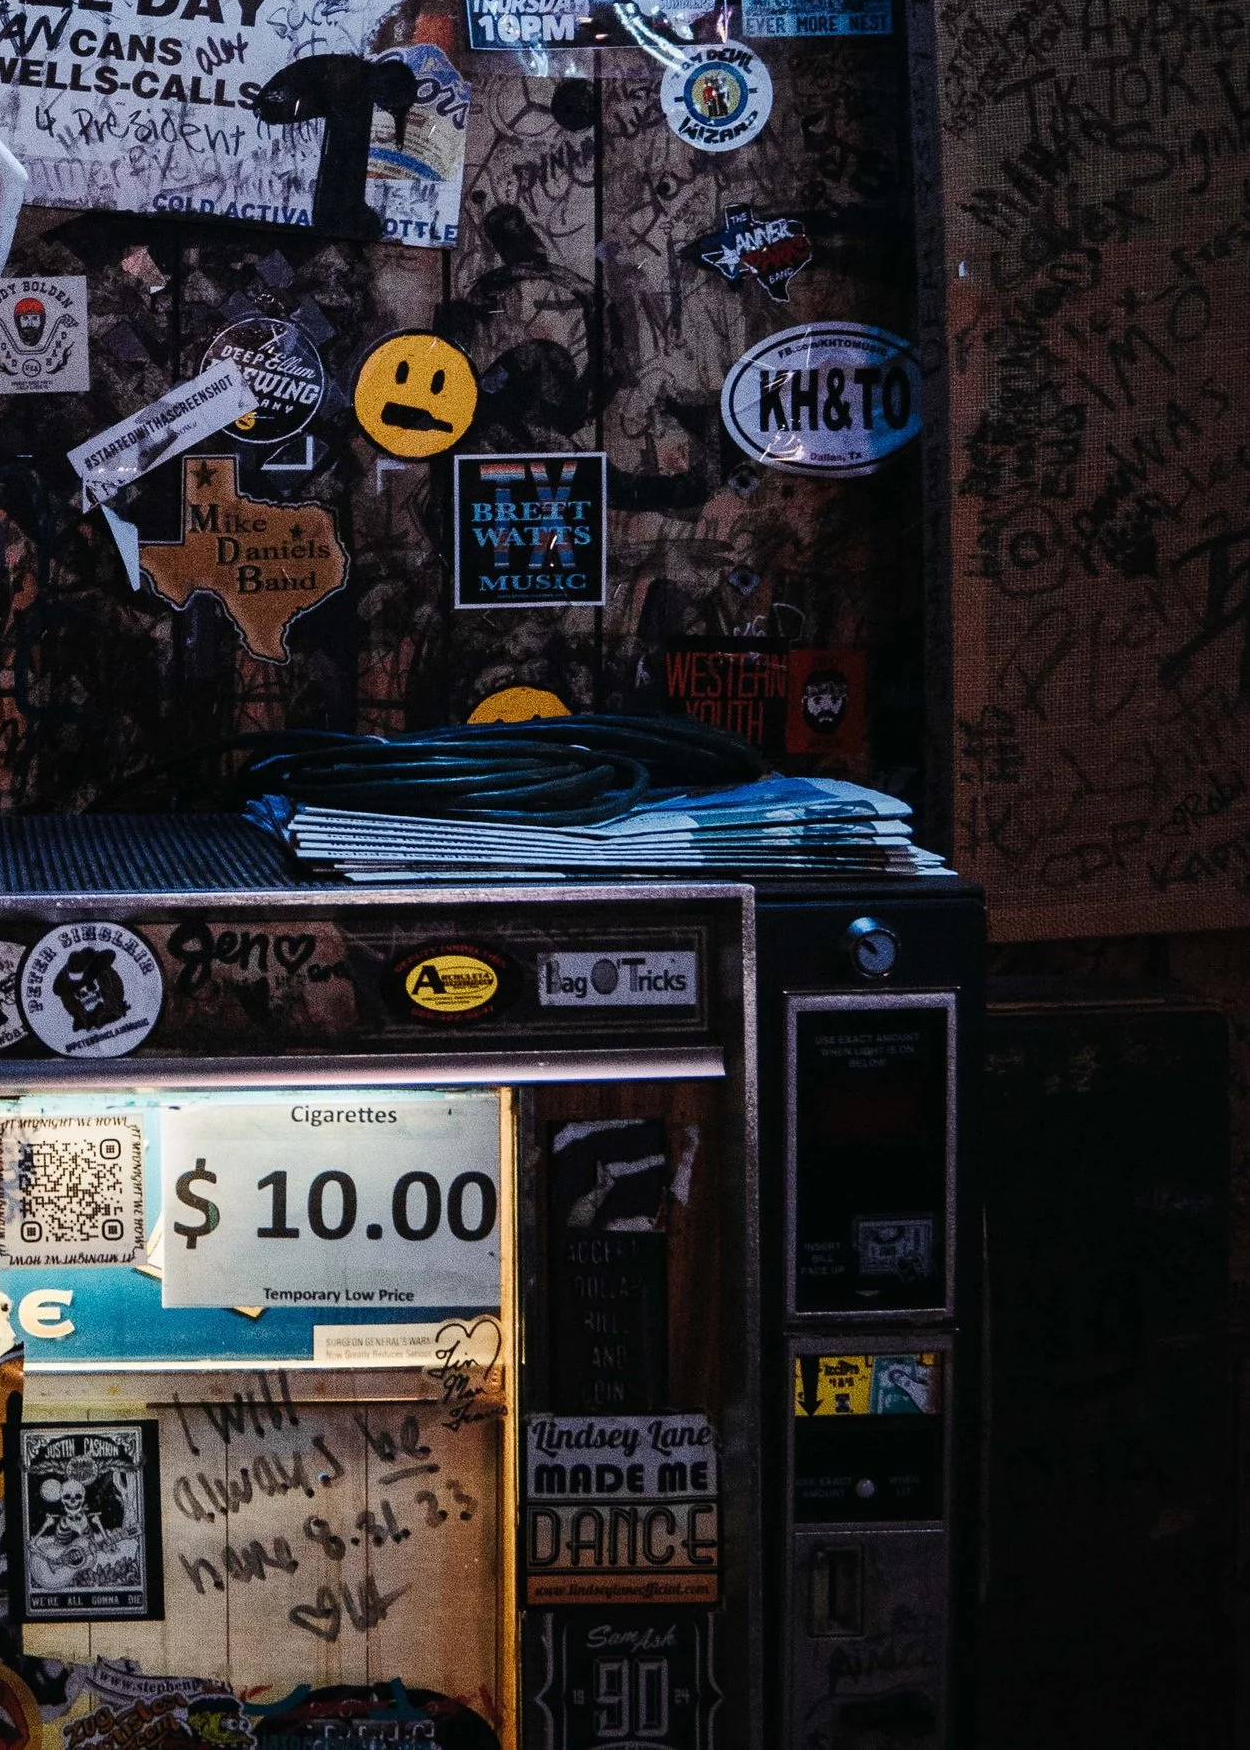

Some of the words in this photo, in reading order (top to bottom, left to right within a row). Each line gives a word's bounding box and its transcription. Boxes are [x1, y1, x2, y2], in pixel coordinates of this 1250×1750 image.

[477, 14, 576, 43] 10PM
[745, 16, 787, 35] EVER
[796, 14, 839, 34] MORE
[849, 13, 890, 33] NEST
[68, 28, 182, 66] CANS
[151, 192, 216, 216] COLD
[380, 218, 459, 244] OTTLE
[21, 279, 74, 310] BOLDEN
[221, 344, 264, 368] DEEP
[265, 354, 317, 380] Ellum
[757, 365, 913, 436] KH&TO
[83, 373, 235, 473] #STARTEDWITHASCREENSHOT
[188, 503, 268, 535] Mike
[470, 499, 593, 524] BRETT
[215, 536, 331, 568] Daniels
[471, 524, 594, 549] WATTS
[236, 565, 318, 597] Band
[478, 572, 588, 592] MUSIC
[665, 651, 790, 699] WESTERN
[685, 699, 766, 745] YOUTH
[27, 946, 58, 1014] PETER
[58, 924, 156, 976] SINCLAIR
[544, 960, 588, 998] Bag
[290, 1104, 398, 1129] Cigarettes
[172, 1157, 220, 1249] $
[256, 1170, 498, 1242] 10.00
[262, 1285, 341, 1305] Temporary
[344, 1286, 374, 1303] Low
[377, 1286, 415, 1303] Price
[326, 1337, 364, 1347] SURGEON
[409, 1336, 434, 1346] WARN
[43, 1437, 77, 1460] JUSTIN
[82, 1436, 121, 1458] CASHION
[531, 1420, 641, 1456] Lindsey
[647, 1419, 711, 1455] Lane
[534, 1463, 644, 1494] MADE
[657, 1461, 709, 1492] ME
[529, 1503, 719, 1568] DANCE
[30, 1595, 61, 1609] WE'RE
[65, 1595, 86, 1608] ALL
[90, 1594, 122, 1607] GONNA
[126, 1593, 143, 1607] DIE
[595, 1658, 670, 1738] 90
